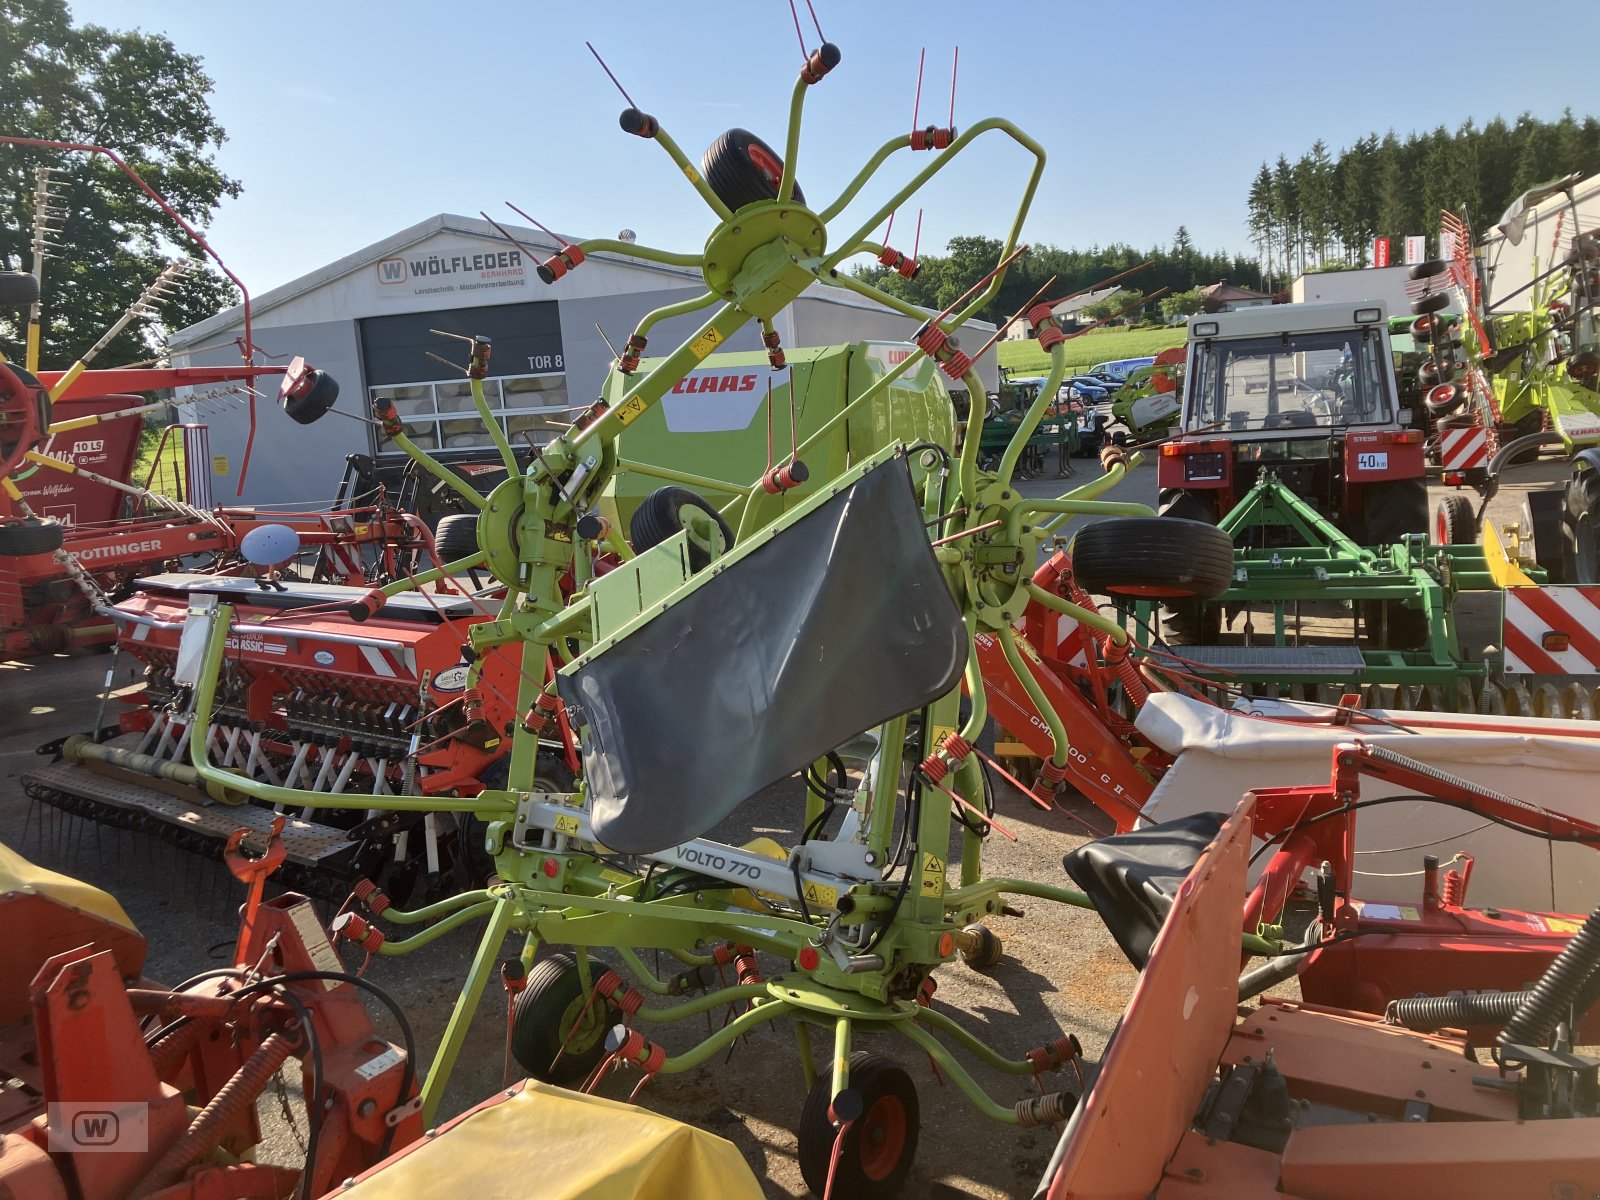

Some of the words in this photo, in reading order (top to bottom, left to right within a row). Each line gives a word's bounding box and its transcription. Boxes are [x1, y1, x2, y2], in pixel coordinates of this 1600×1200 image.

[410, 250, 522, 277] WÖLFLEDER
[480, 268, 524, 279] BERNHARD
[414, 284, 455, 295] Landtechnik
[459, 279, 525, 291] Metallverarbeitung
[527, 355, 552, 370] TOR
[554, 354, 563, 368] 8
[671, 374, 758, 394] CLAAS
[76, 442, 88, 452] 10
[90, 441, 102, 451] LS
[1358, 454, 1376, 468] 40
[1100, 774, 1110, 784] G
[676, 846, 726, 870] VOLTO
[728, 860, 762, 880] 770
